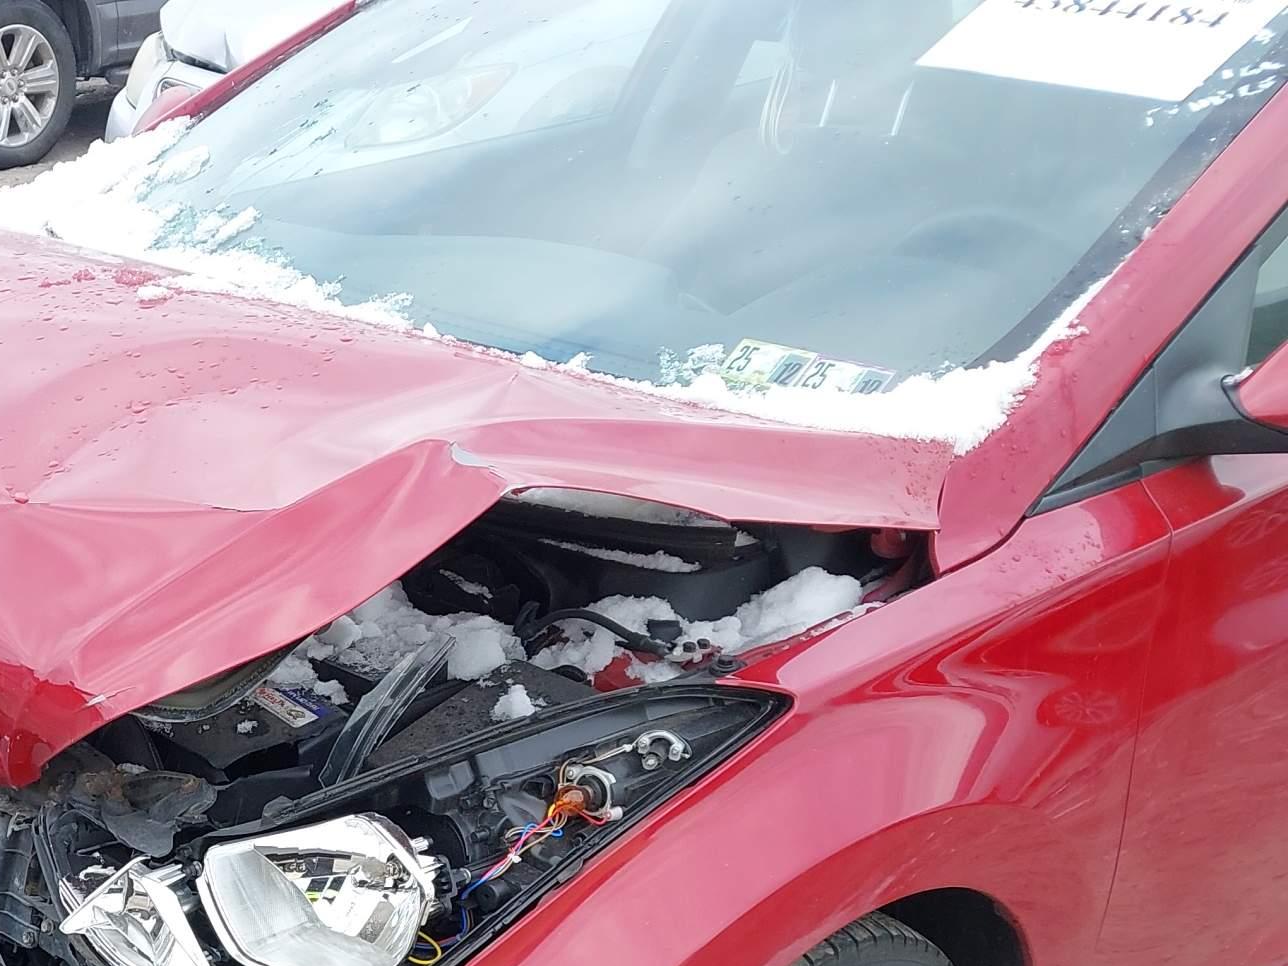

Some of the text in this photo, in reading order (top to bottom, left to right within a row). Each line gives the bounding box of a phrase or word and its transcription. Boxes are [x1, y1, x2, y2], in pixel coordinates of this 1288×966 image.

[727, 345, 803, 385] 25 12
[801, 361, 836, 389] 25
